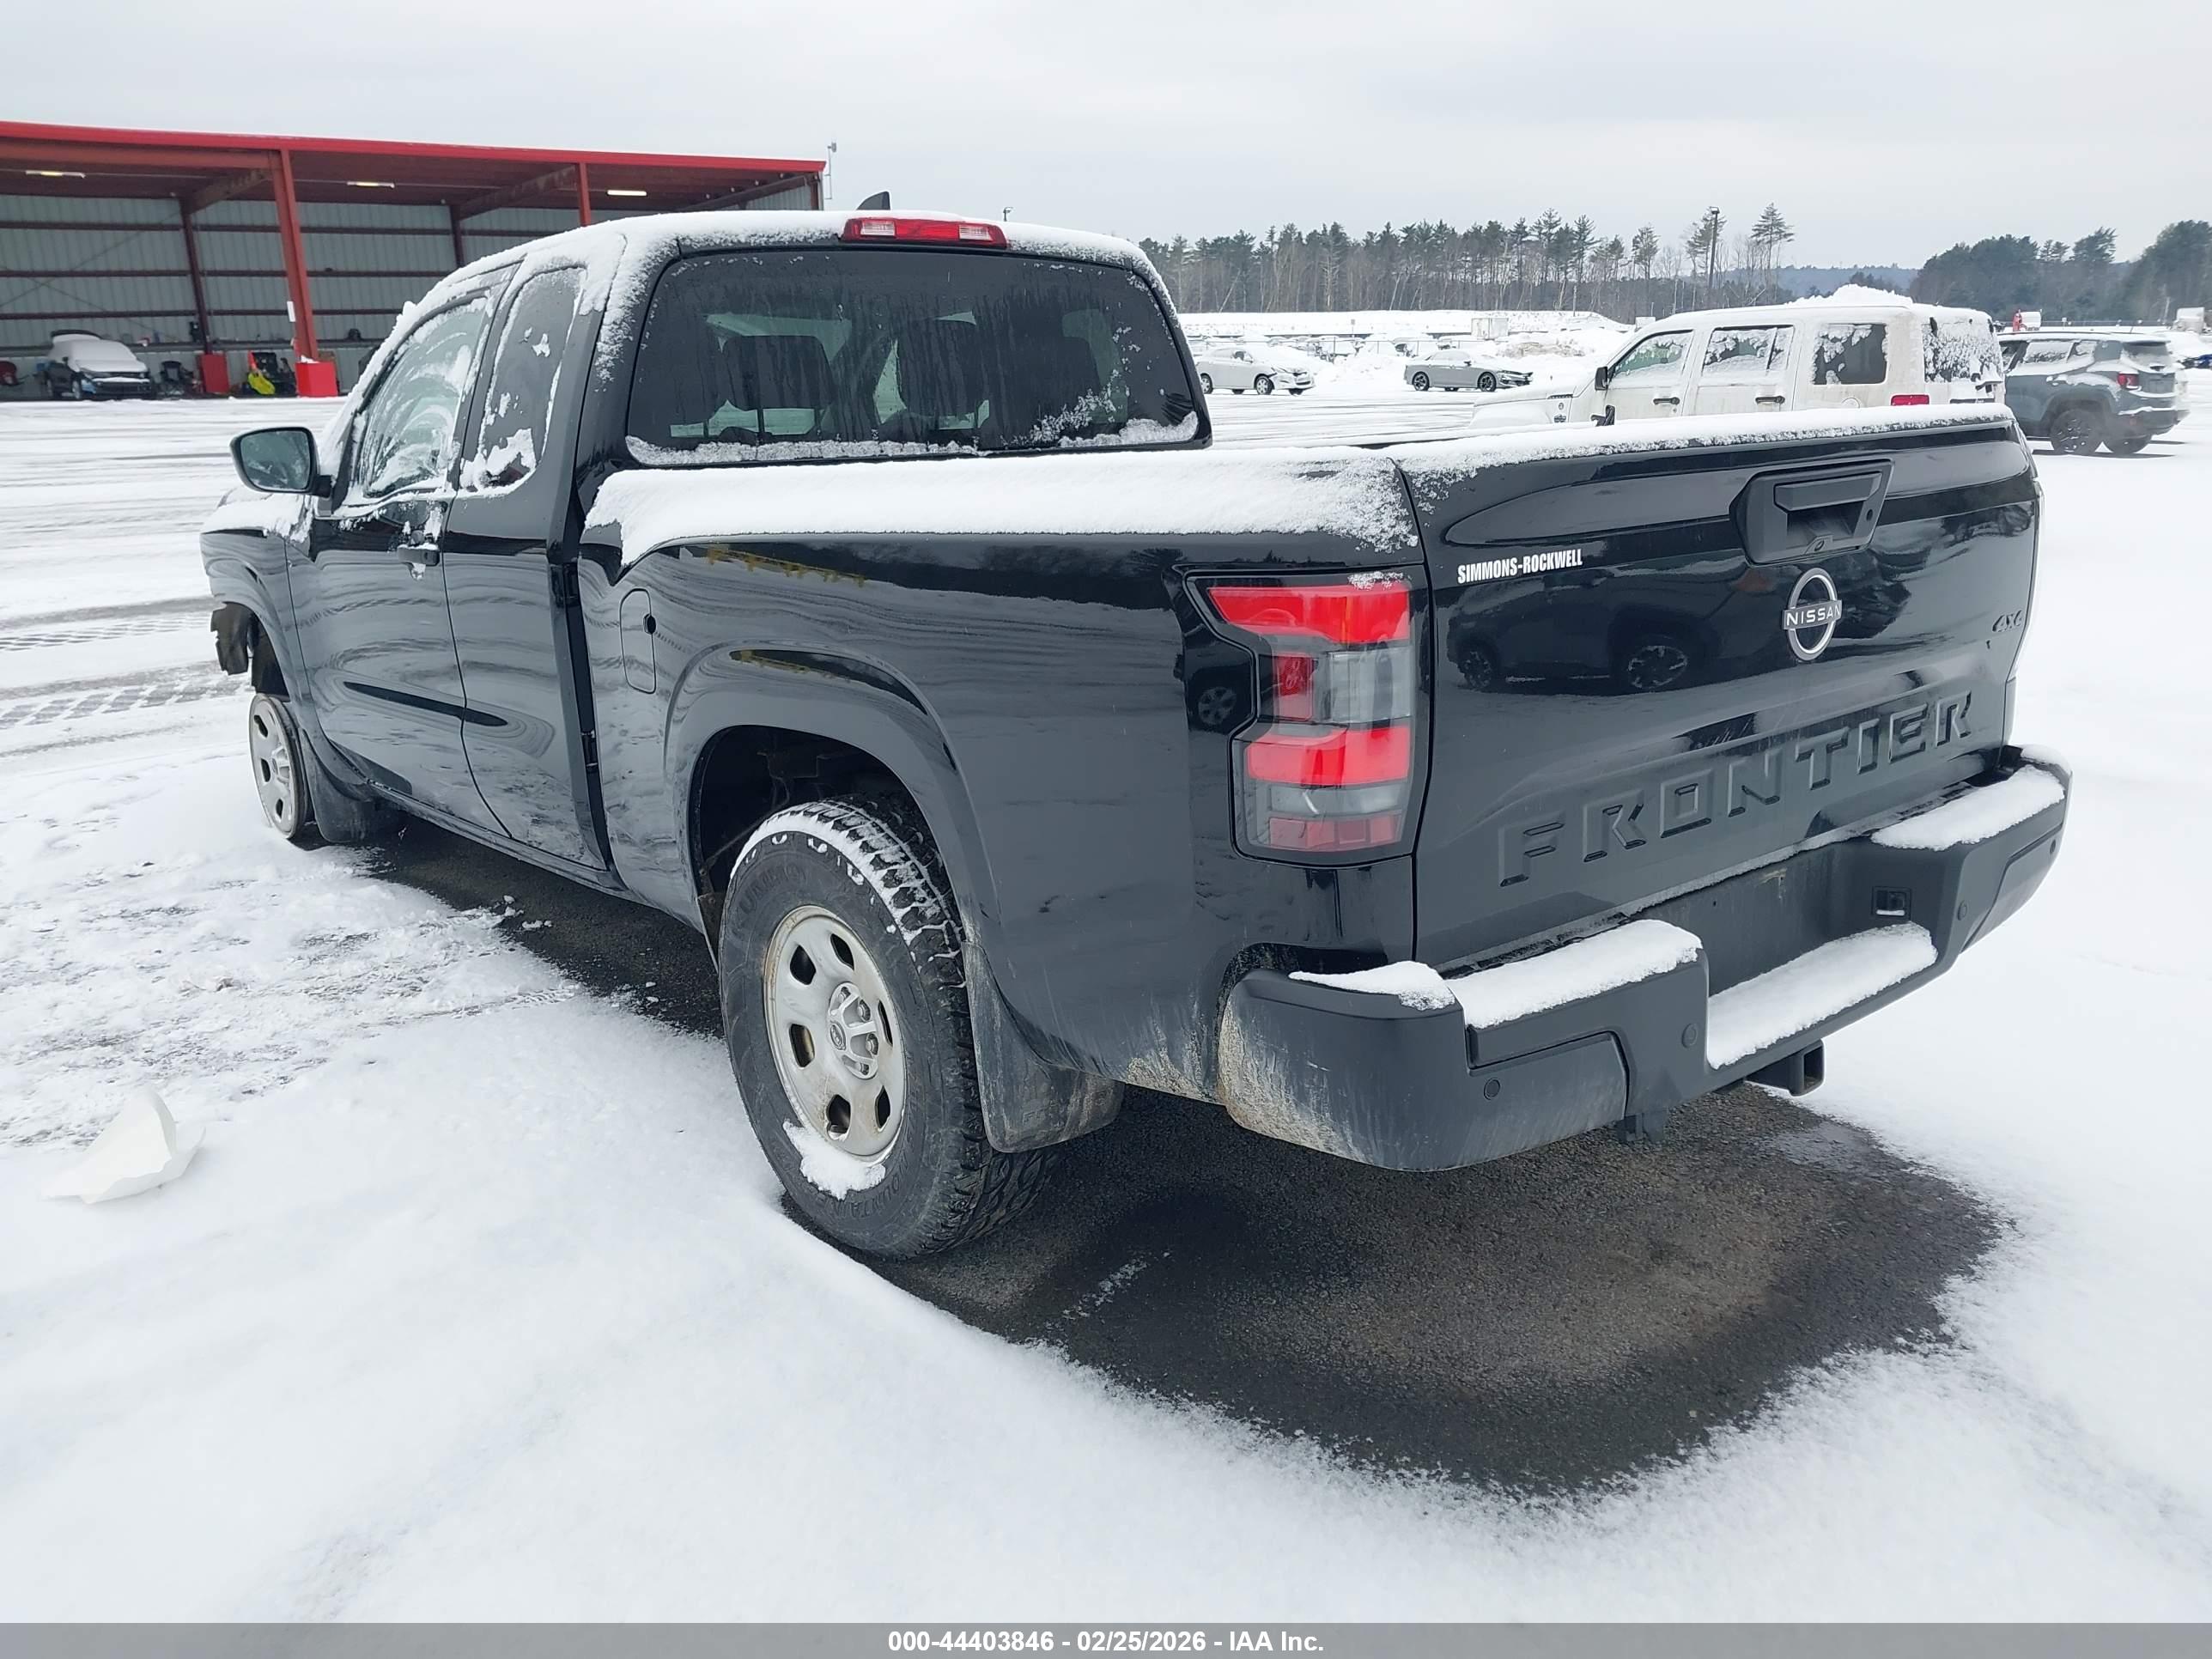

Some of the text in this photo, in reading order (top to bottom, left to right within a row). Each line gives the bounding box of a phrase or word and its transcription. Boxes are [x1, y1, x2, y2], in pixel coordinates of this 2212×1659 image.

[1457, 548, 1583, 585] SIMMONS-ROCKWELL
[1786, 604, 1840, 626] NISSAN
[1498, 689, 1973, 887] FRONTIER
